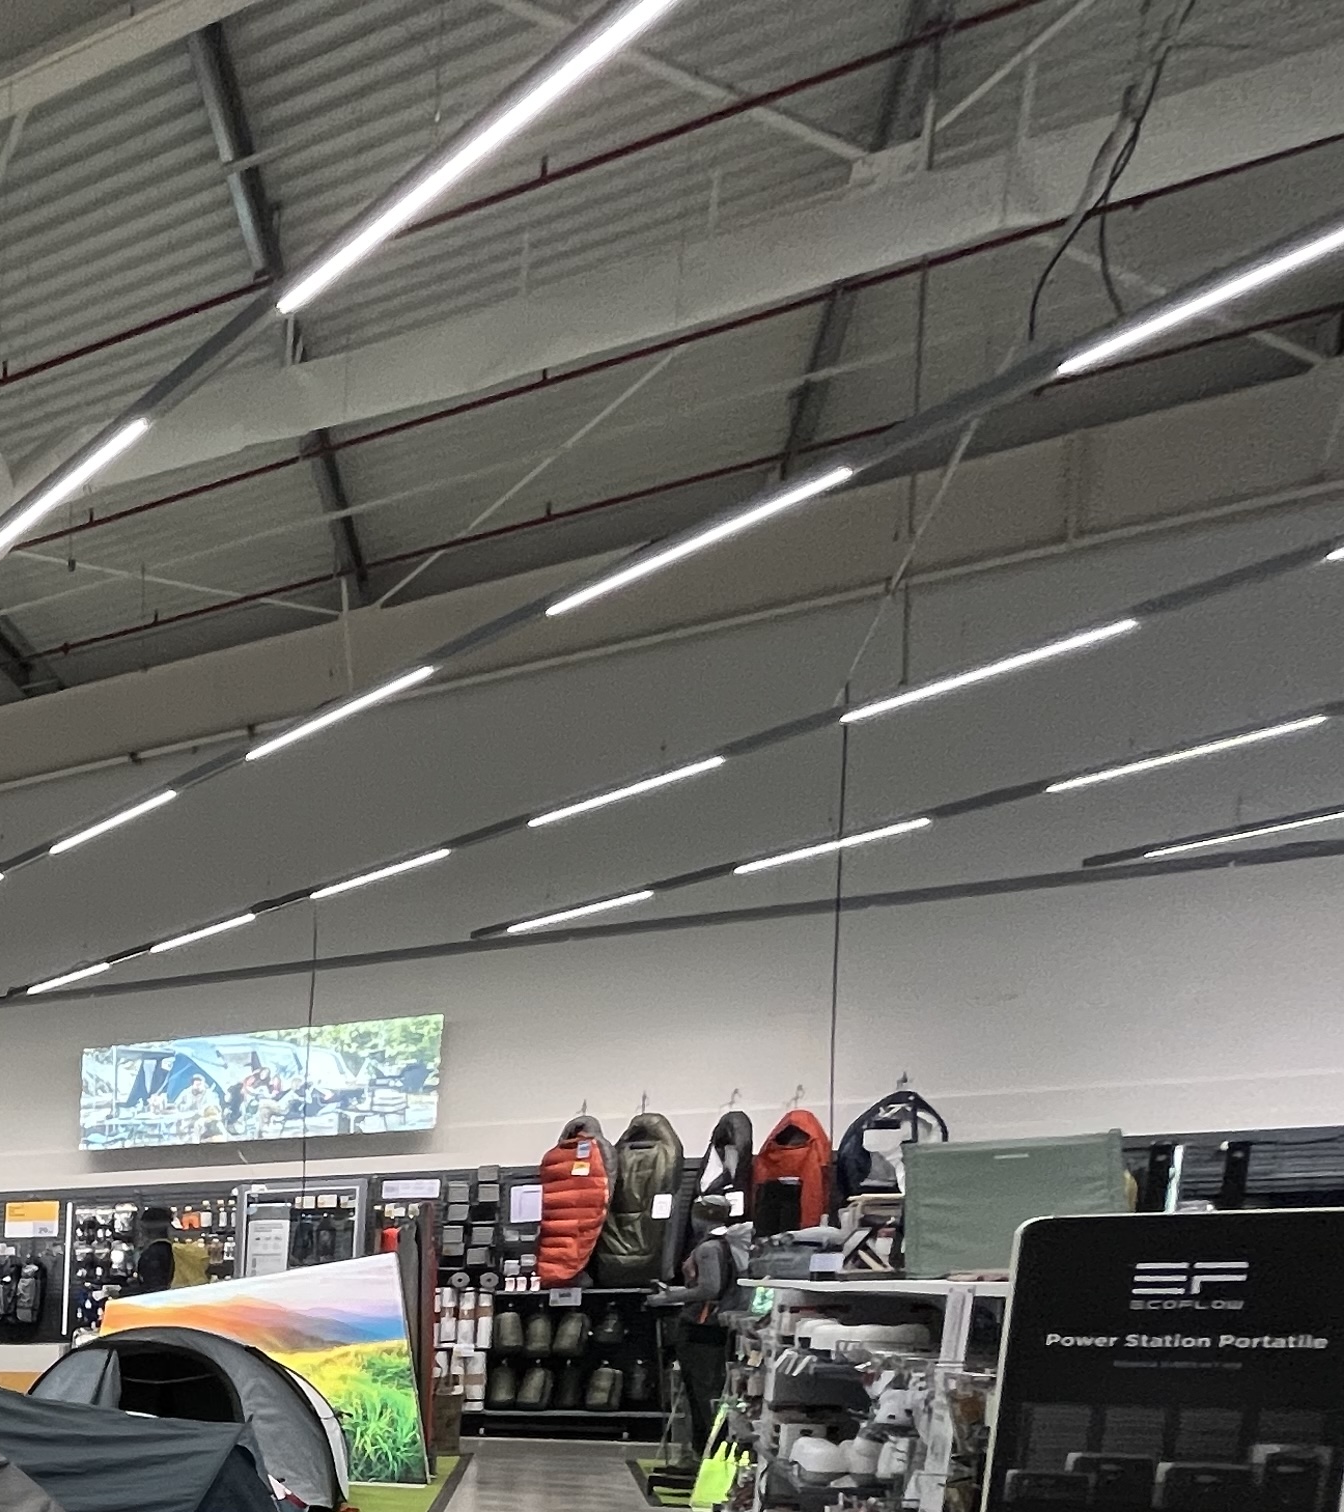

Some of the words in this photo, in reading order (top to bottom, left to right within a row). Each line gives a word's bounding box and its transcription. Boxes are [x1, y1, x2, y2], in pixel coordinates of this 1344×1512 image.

[1128, 1299, 1245, 1311] ECOFLOW
[1045, 1333, 1120, 1348] Power
[1123, 1333, 1212, 1349] Station
[1218, 1333, 1330, 1350] Portatile
